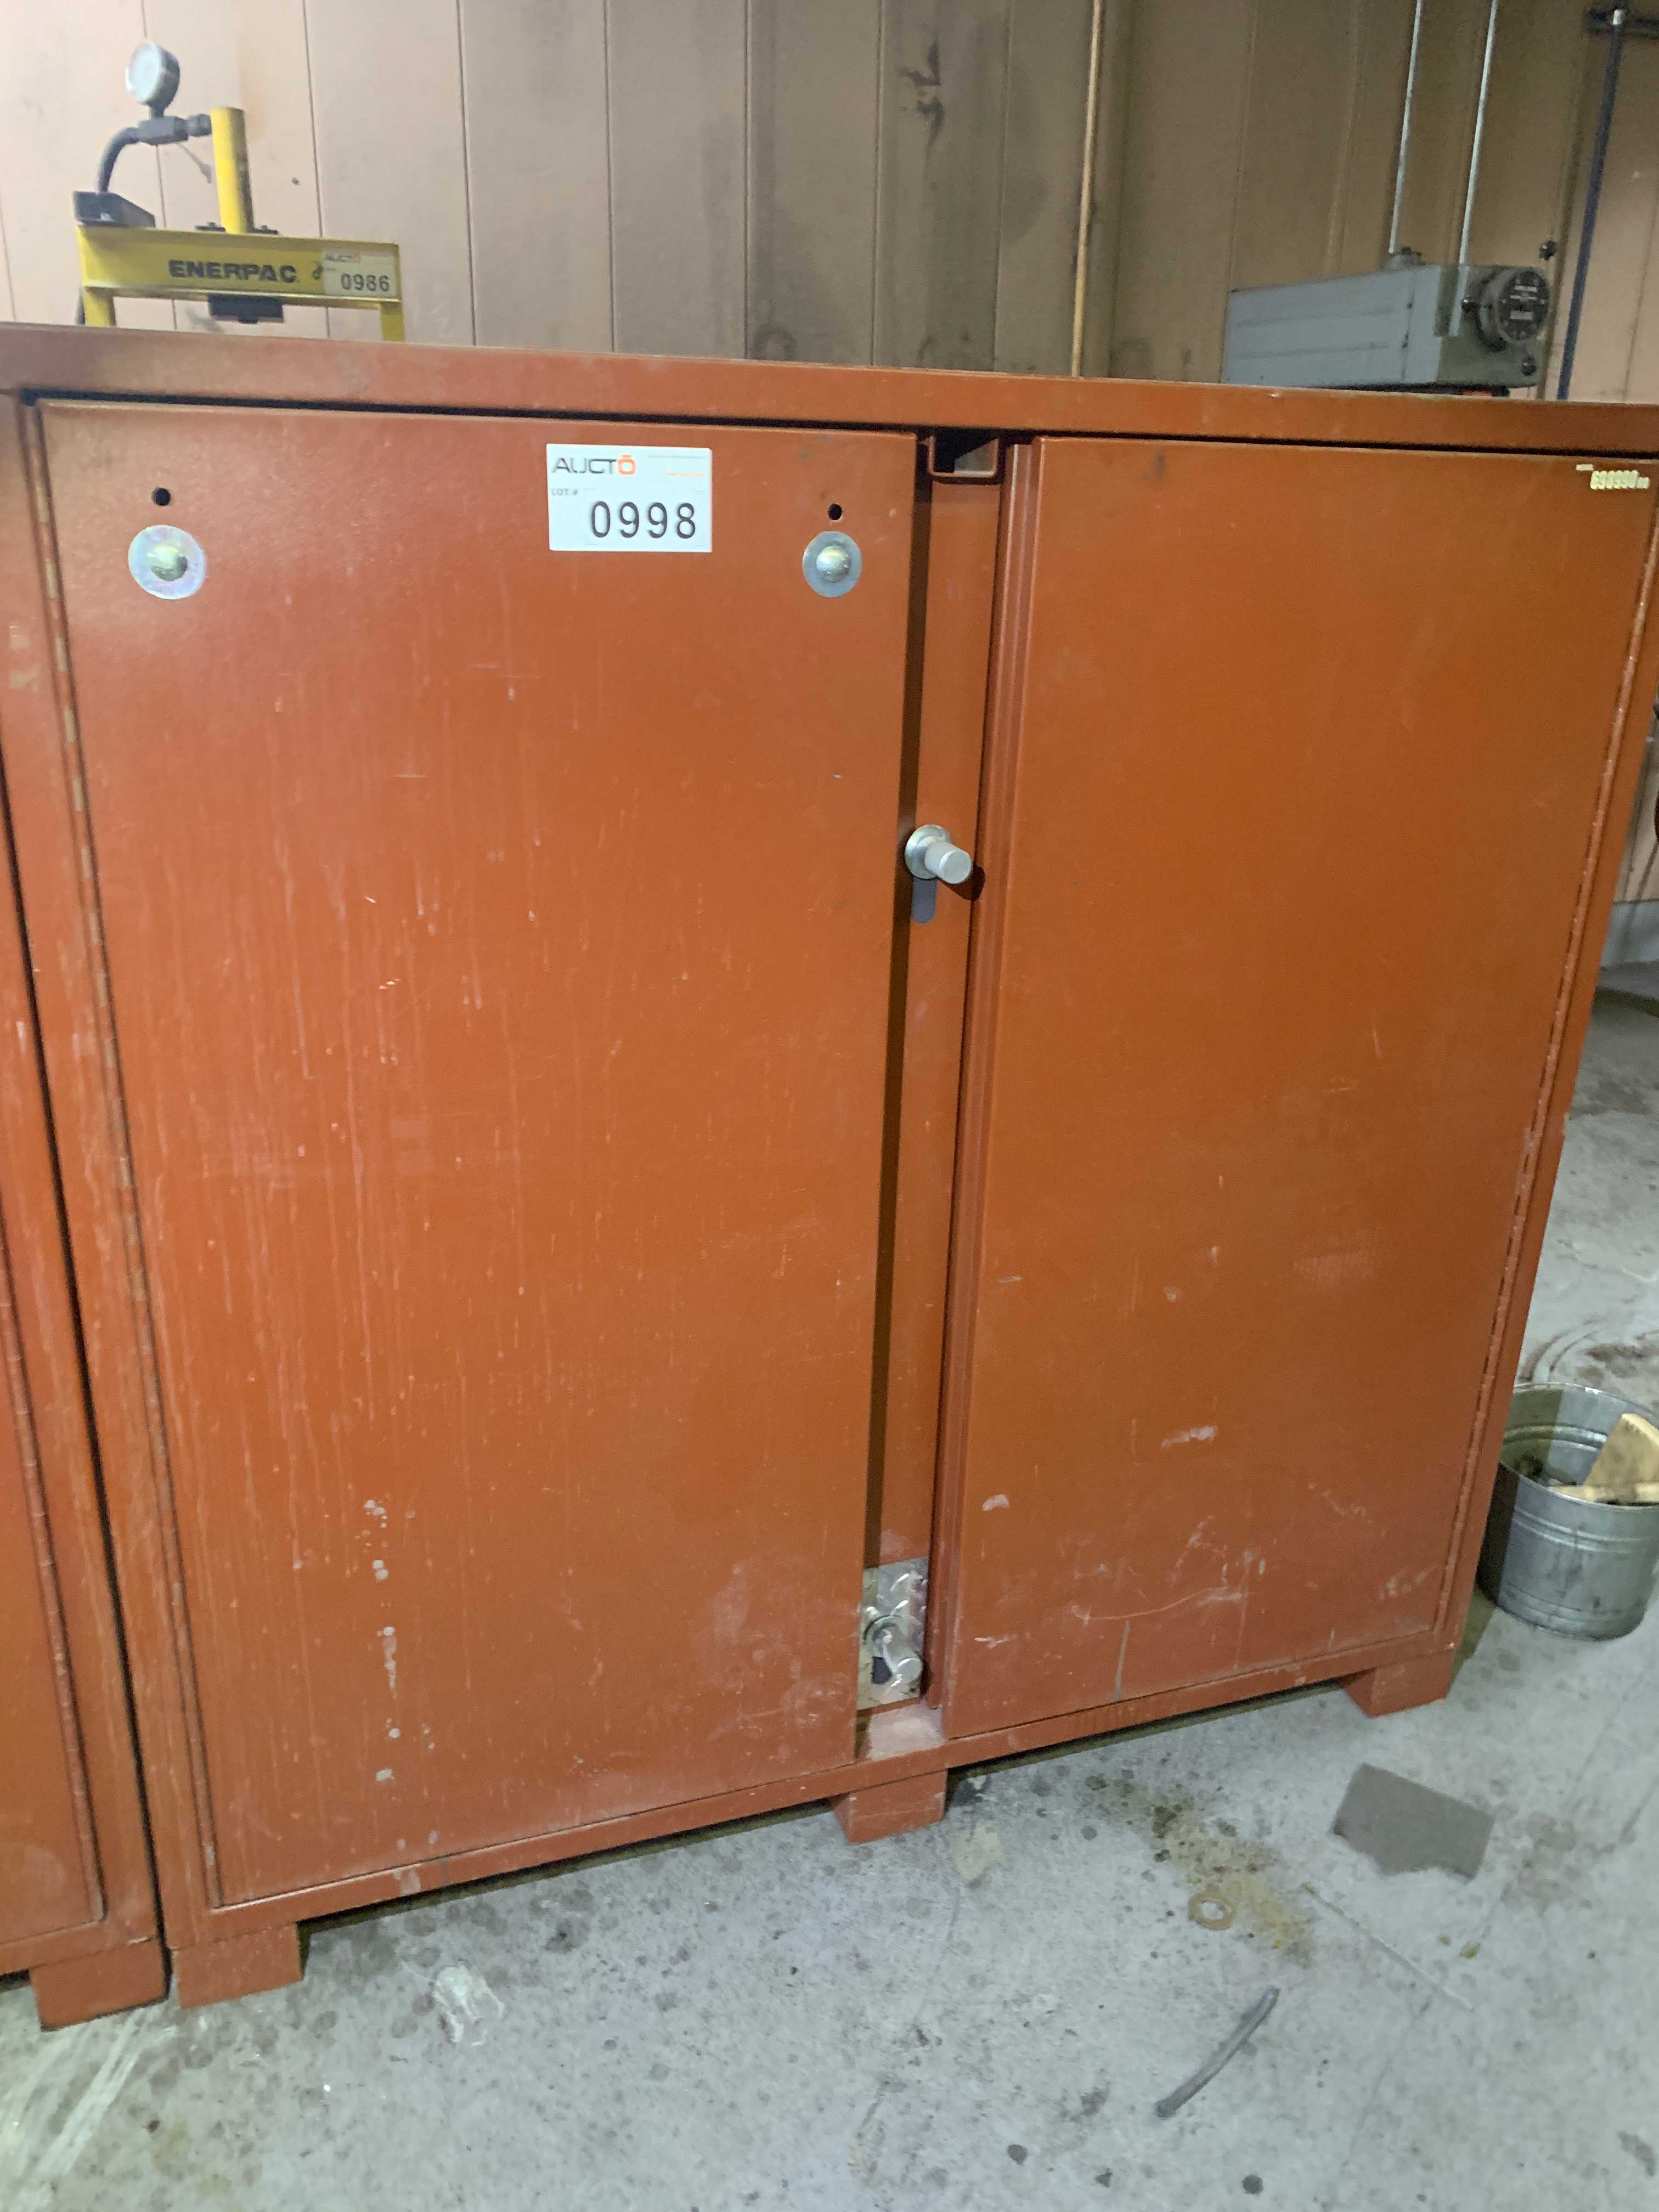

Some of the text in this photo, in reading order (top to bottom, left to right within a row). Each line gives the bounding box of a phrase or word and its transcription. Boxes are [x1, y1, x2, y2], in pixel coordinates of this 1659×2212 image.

[168, 259, 296, 284] ENERPAC
[341, 273, 390, 292] 0986
[589, 500, 696, 539] 0998
